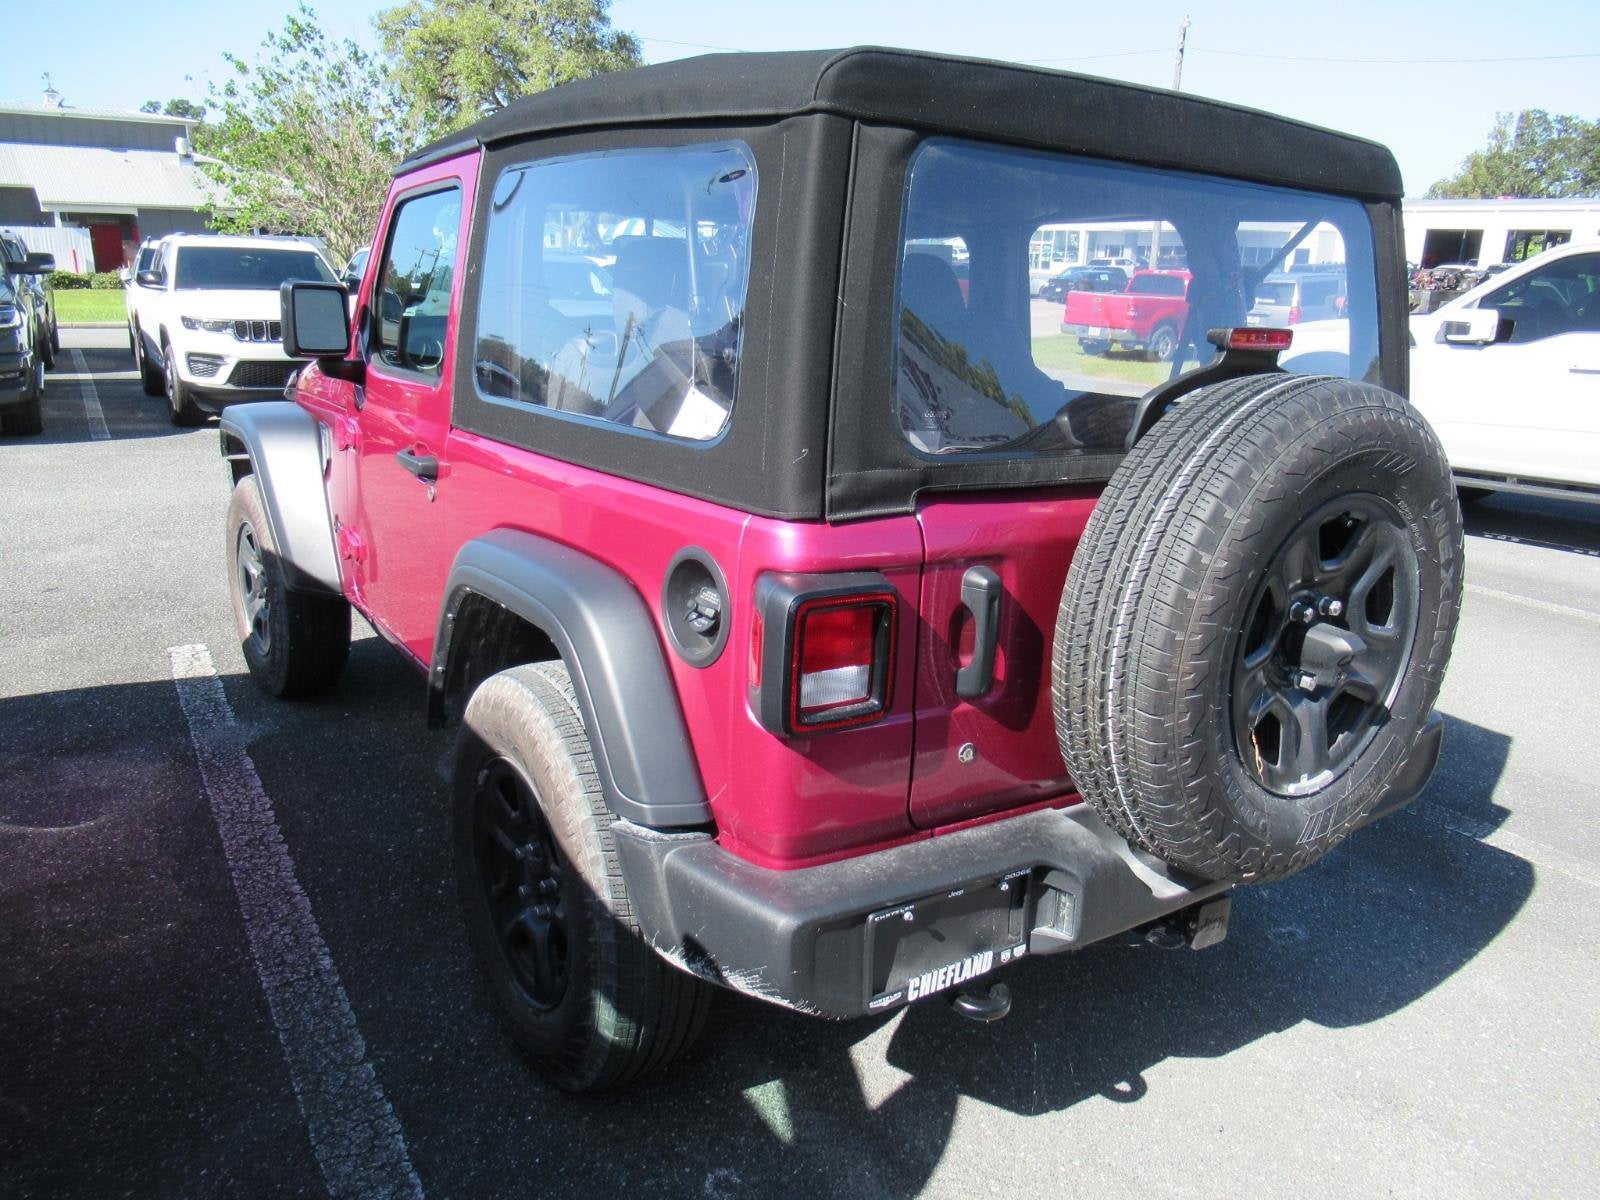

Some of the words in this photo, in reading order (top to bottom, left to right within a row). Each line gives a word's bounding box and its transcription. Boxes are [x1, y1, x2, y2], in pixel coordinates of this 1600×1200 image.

[1004, 867, 1032, 880] DODGE
[948, 889, 964, 898] Jeep
[874, 904, 915, 921] CHRYSLER
[907, 950, 994, 1002] CHIEFLAND
